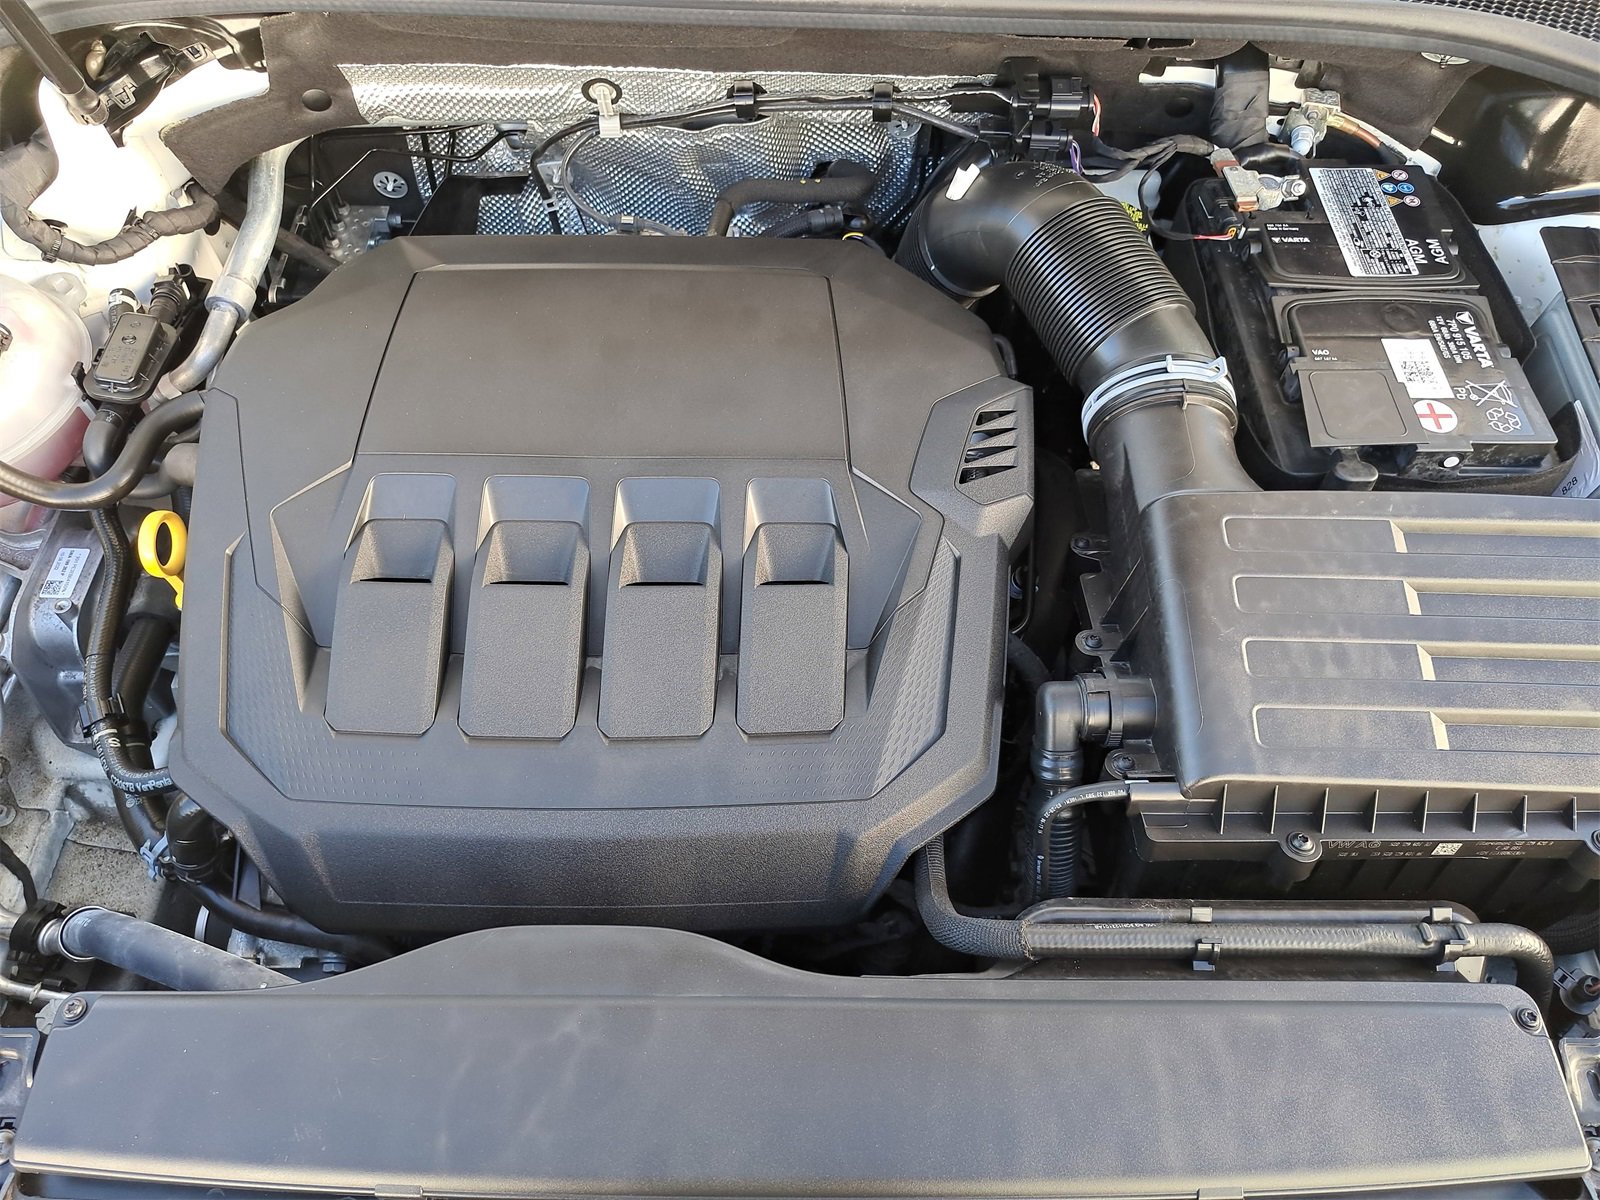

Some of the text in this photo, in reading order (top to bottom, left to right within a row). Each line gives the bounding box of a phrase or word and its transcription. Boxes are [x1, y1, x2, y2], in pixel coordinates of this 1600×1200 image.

[1405, 238, 1428, 264] AGM
[1425, 238, 1449, 265] AGM
[1452, 333, 1466, 346] 915
[1459, 347, 1472, 360] 105
[1464, 325, 1492, 368] VARTA
[1454, 387, 1468, 400] Pb
[1561, 476, 1578, 495] 828
